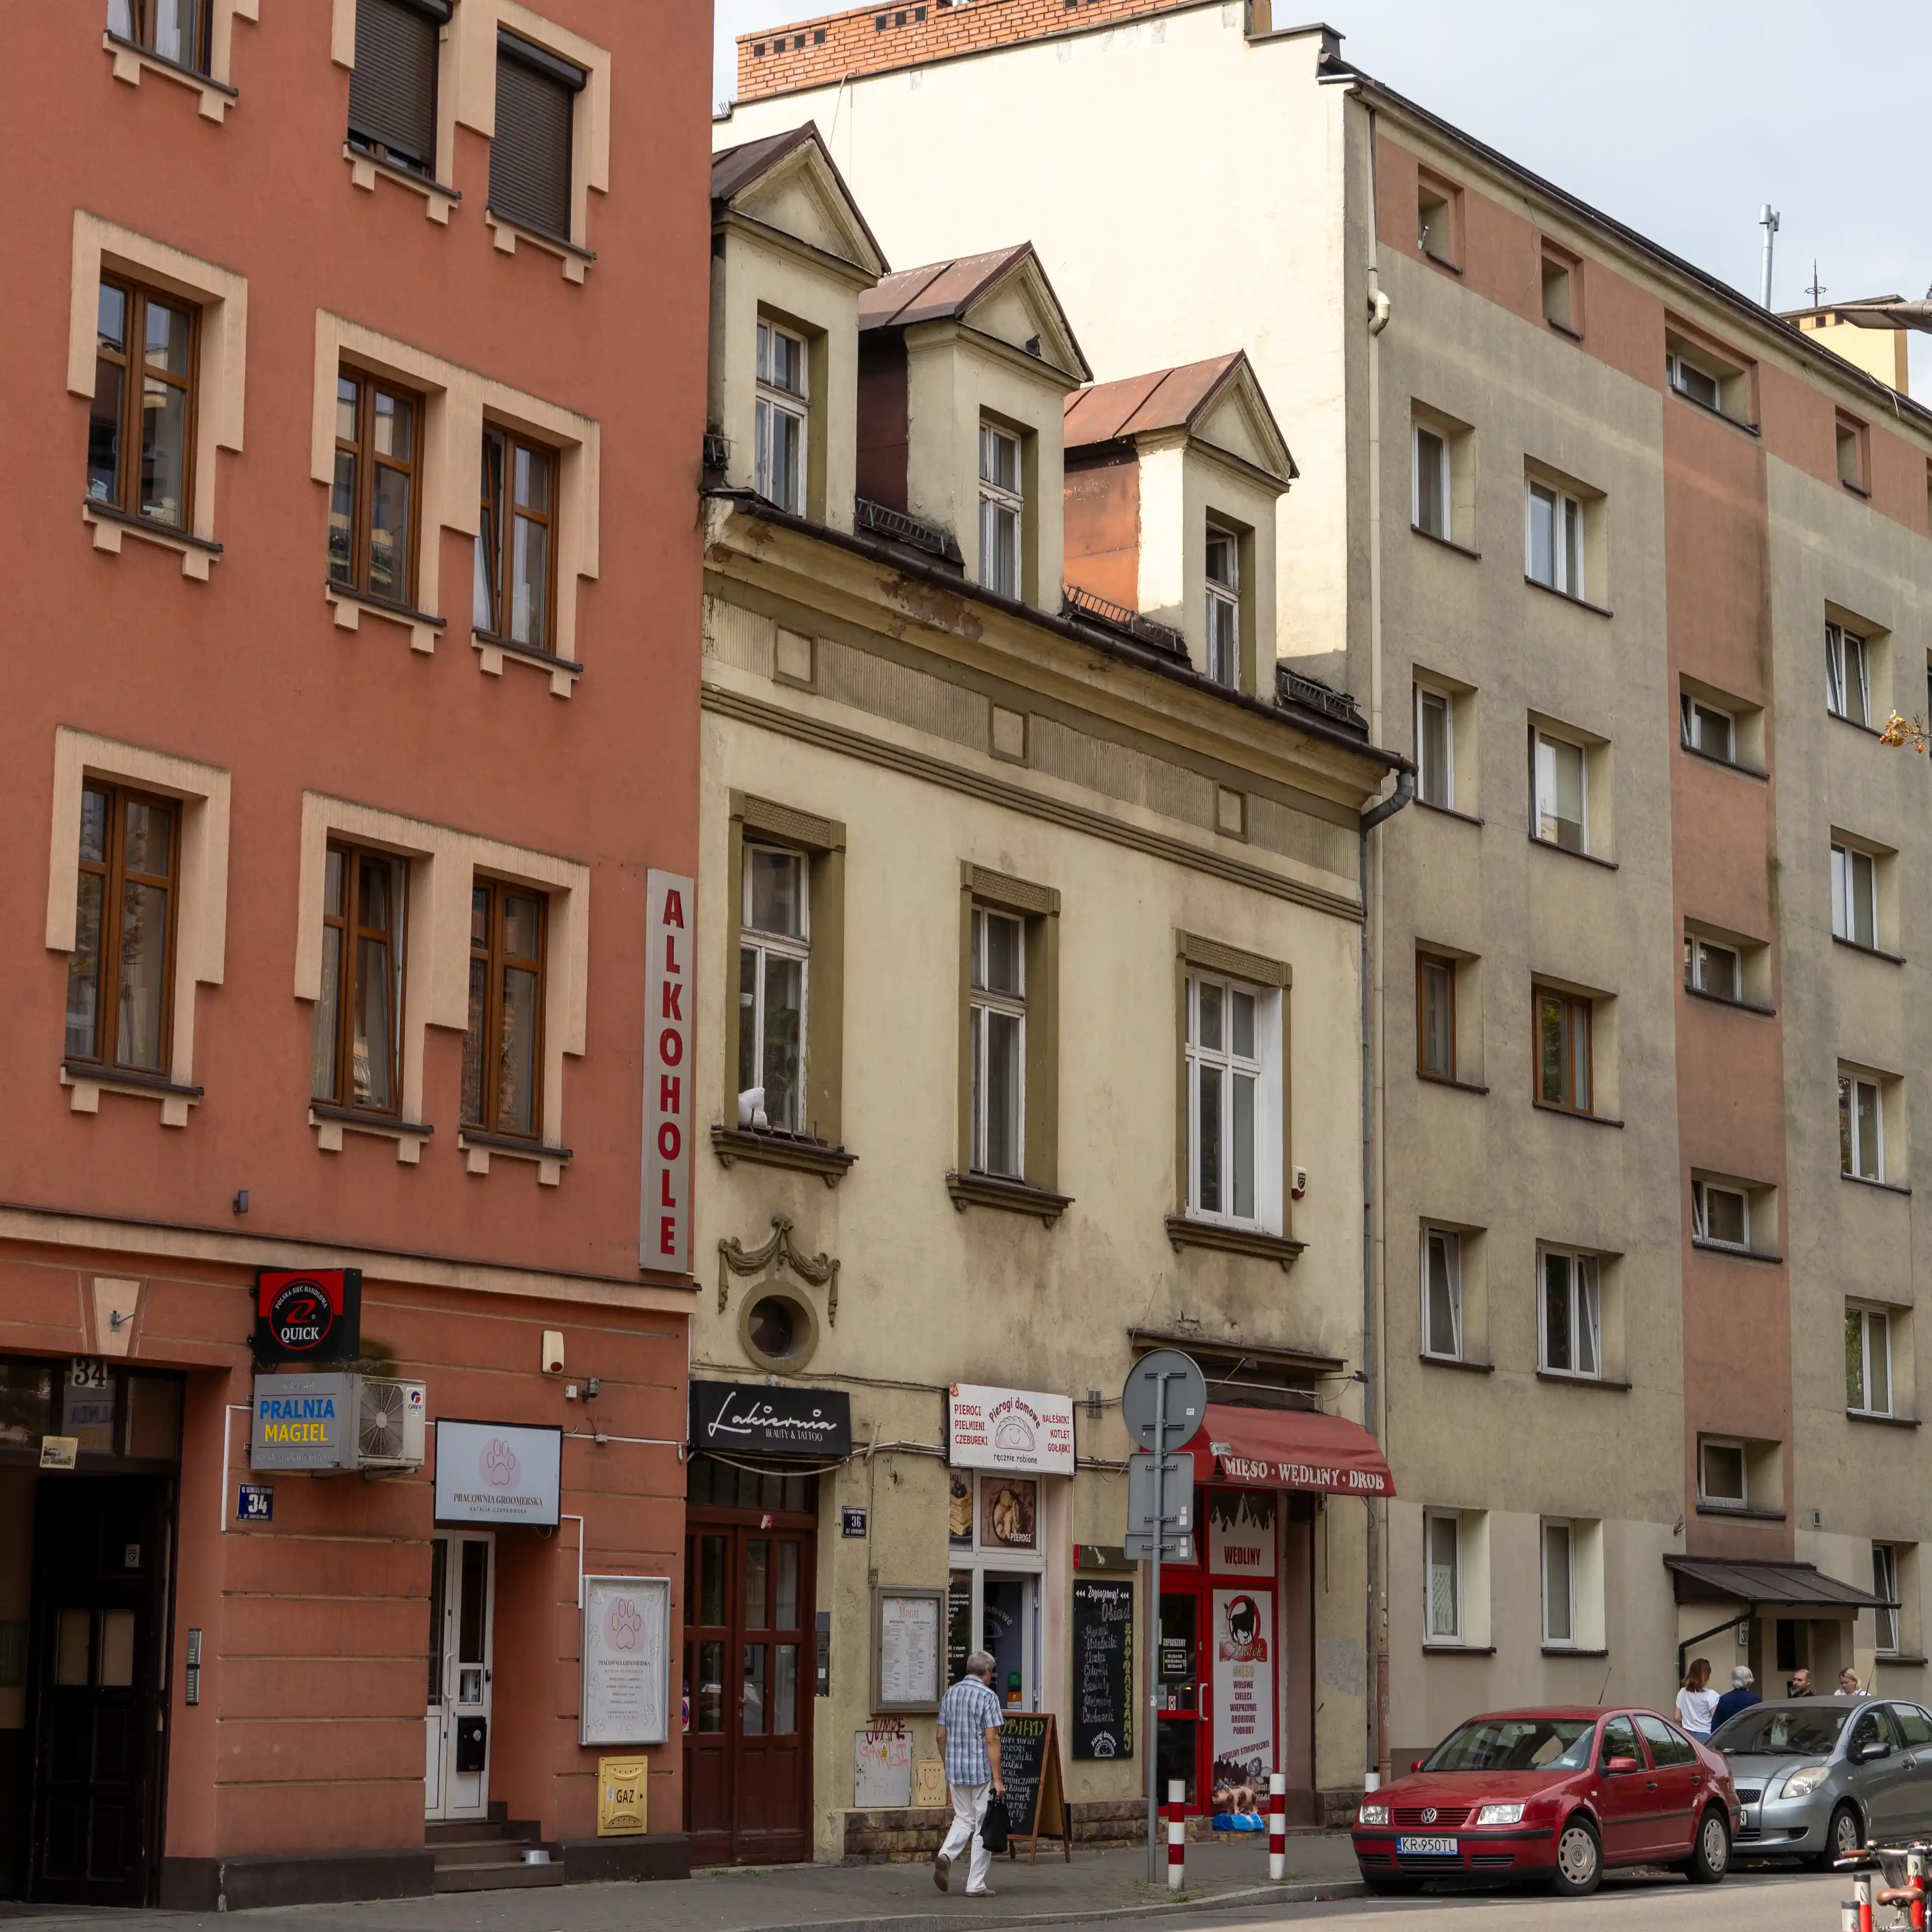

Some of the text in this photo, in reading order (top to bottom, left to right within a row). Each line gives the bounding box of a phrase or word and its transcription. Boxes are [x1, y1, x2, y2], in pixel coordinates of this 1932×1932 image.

[658, 889, 684, 1255] ALKOHOLE
[275, 1284, 329, 1309] POLSKA SIEĆ HANDLOWA
[281, 1327, 319, 1343] QUICK
[74, 1357, 106, 1388] 34
[260, 1399, 335, 1419] PRALNIA
[708, 1391, 837, 1437] Lakiernia
[989, 1397, 1040, 1429] Pierogi domowe
[955, 1420, 985, 1431] PIELMIENI
[1042, 1413, 1070, 1424] NALEŚNIKI
[264, 1423, 329, 1442] MAGIEL
[765, 1428, 823, 1441] BEAUTY & TATTOO
[1050, 1429, 1070, 1438] KOTLET
[955, 1435, 988, 1445] CZEBUREKI
[1048, 1443, 1071, 1455] GOŁĄBKI
[994, 1453, 1037, 1464] ręcznie robione
[1224, 1457, 1268, 1480] MIĘSO
[1278, 1463, 1340, 1486] WĘDLINY
[248, 1494, 267, 1513] 34
[453, 1493, 542, 1507] PRACOWNIA GROOMERSKA
[852, 1516, 861, 1527] 36
[1010, 1533, 1031, 1542] PIEROGI
[1224, 1546, 1261, 1567] WĘDLINY
[1088, 1585, 1119, 1605] Zapraszamy!
[899, 1606, 919, 1618] Menu
[1102, 1601, 1131, 1622] Obiad
[1233, 1665, 1254, 1679] MIĘSO
[1123, 1622, 1132, 1750] ZAPRASZAMY
[1233, 1680, 1253, 1689] WOŁOWE
[1235, 1692, 1252, 1702] CIELĘCE
[1230, 1704, 1257, 1712] WIEPRZOWE
[1231, 1715, 1255, 1723] DROBIOWE
[1233, 1726, 1254, 1735] PODROBY
[1240, 1740, 1270, 1755] STAROPOLSKIE
[616, 1789, 634, 1803] GAZ
[1403, 1838, 1455, 1852] KR 950TL
